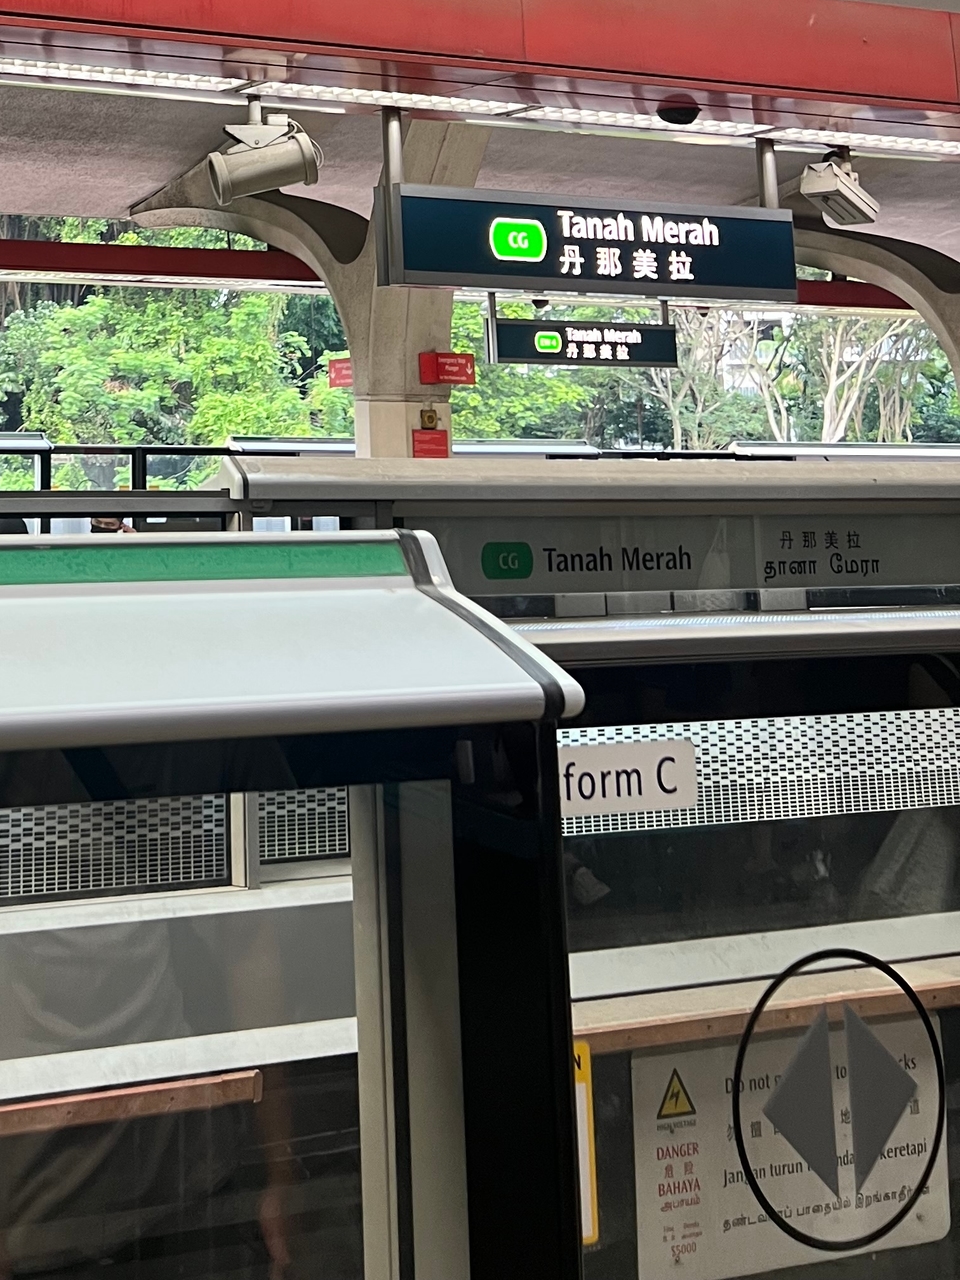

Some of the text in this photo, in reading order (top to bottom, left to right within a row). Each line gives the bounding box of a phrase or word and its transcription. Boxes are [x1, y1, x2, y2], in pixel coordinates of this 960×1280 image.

[557, 210, 720, 246] Tanah Merah
[507, 231, 529, 249] CG
[559, 244, 696, 280] 丹那美拉
[565, 327, 642, 344] Tanah Merah
[779, 531, 862, 550] 丹那美拉
[498, 553, 519, 570] CG
[542, 545, 692, 573] Tanah Merah
[763, 552, 881, 582] தானா மேரா
[656, 756, 678, 794] C
[749, 1073, 771, 1091] not
[656, 1142, 700, 1161] DANGER
[769, 1160, 803, 1178] turun
[658, 1177, 701, 1198] BAHAYA
[671, 1241, 697, 1258] $5000
